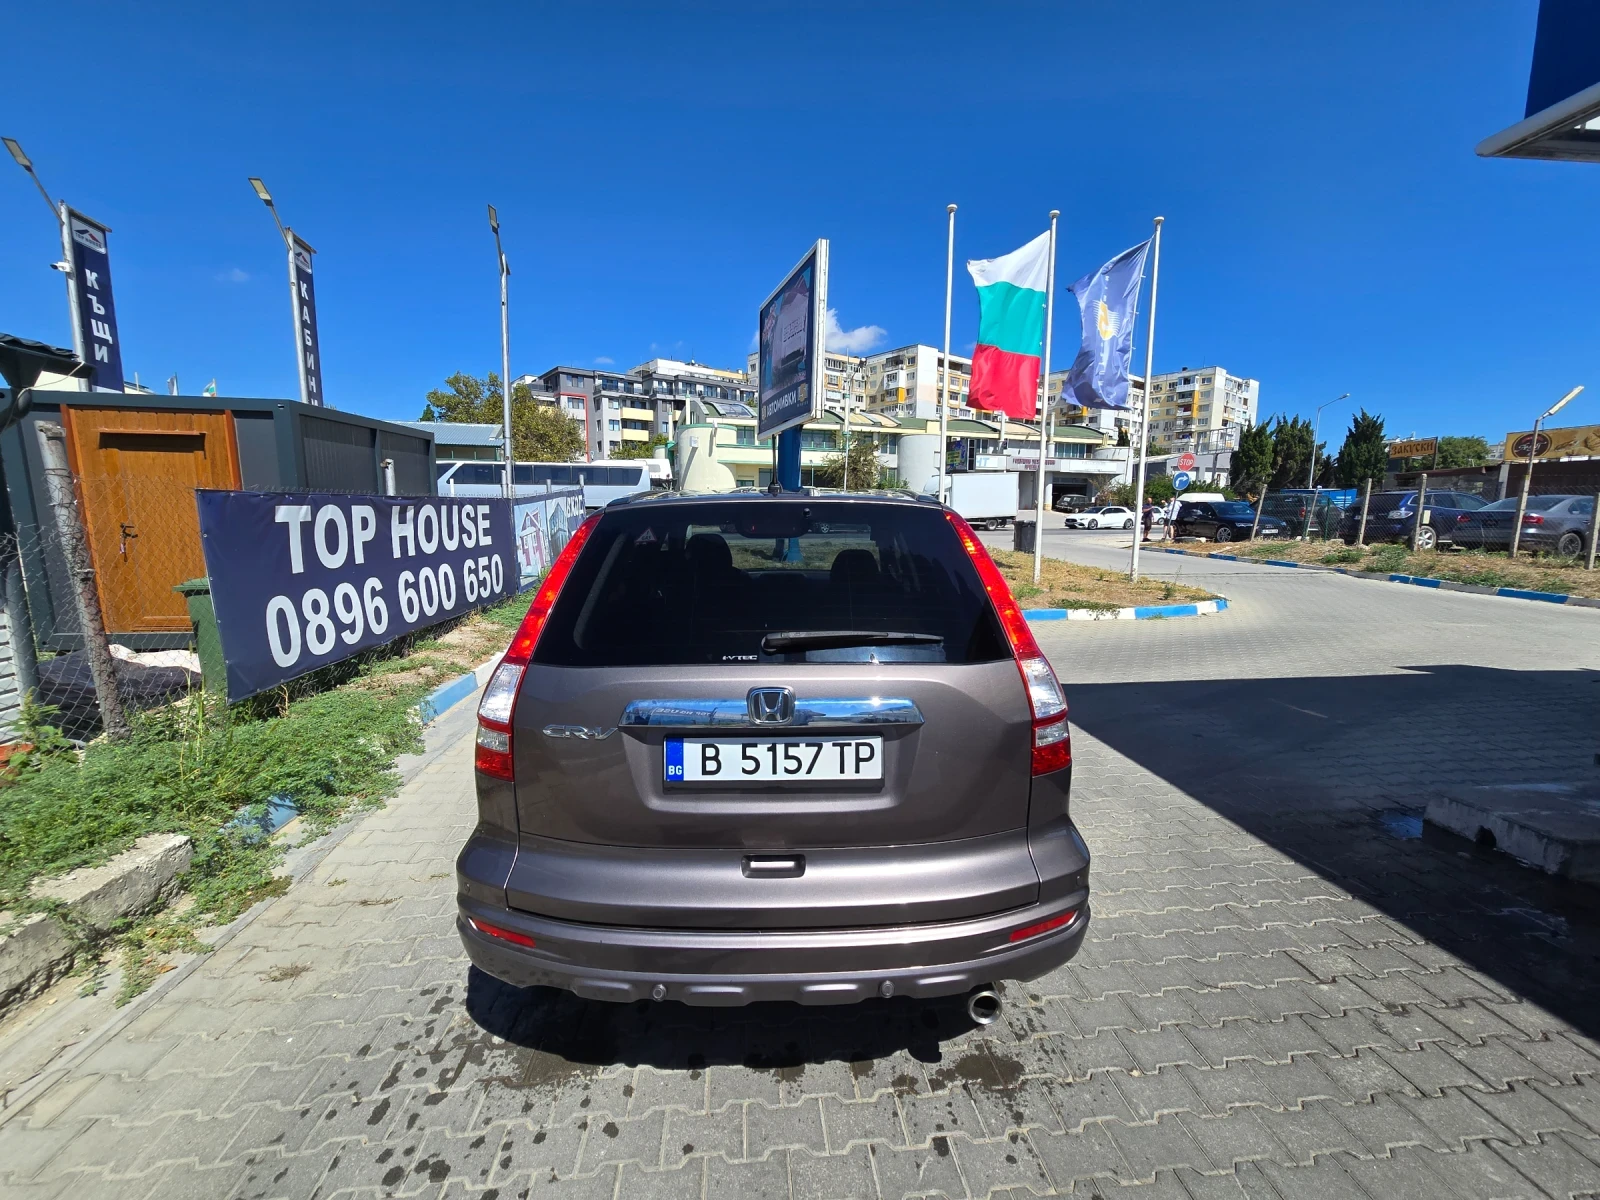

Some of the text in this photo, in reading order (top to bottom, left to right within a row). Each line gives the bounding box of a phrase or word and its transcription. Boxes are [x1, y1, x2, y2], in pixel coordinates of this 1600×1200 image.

[85, 268, 113, 364] КЪЩИ
[767, 390, 797, 418] АВТОМИВКИ
[1179, 458, 1194, 466] STOP
[274, 504, 492, 574] TOP HOUSE
[265, 553, 504, 668] 0896 600 650
[542, 724, 618, 740] CR-V
[668, 765, 682, 775] BG
[701, 742, 875, 775] B 5157 TP
